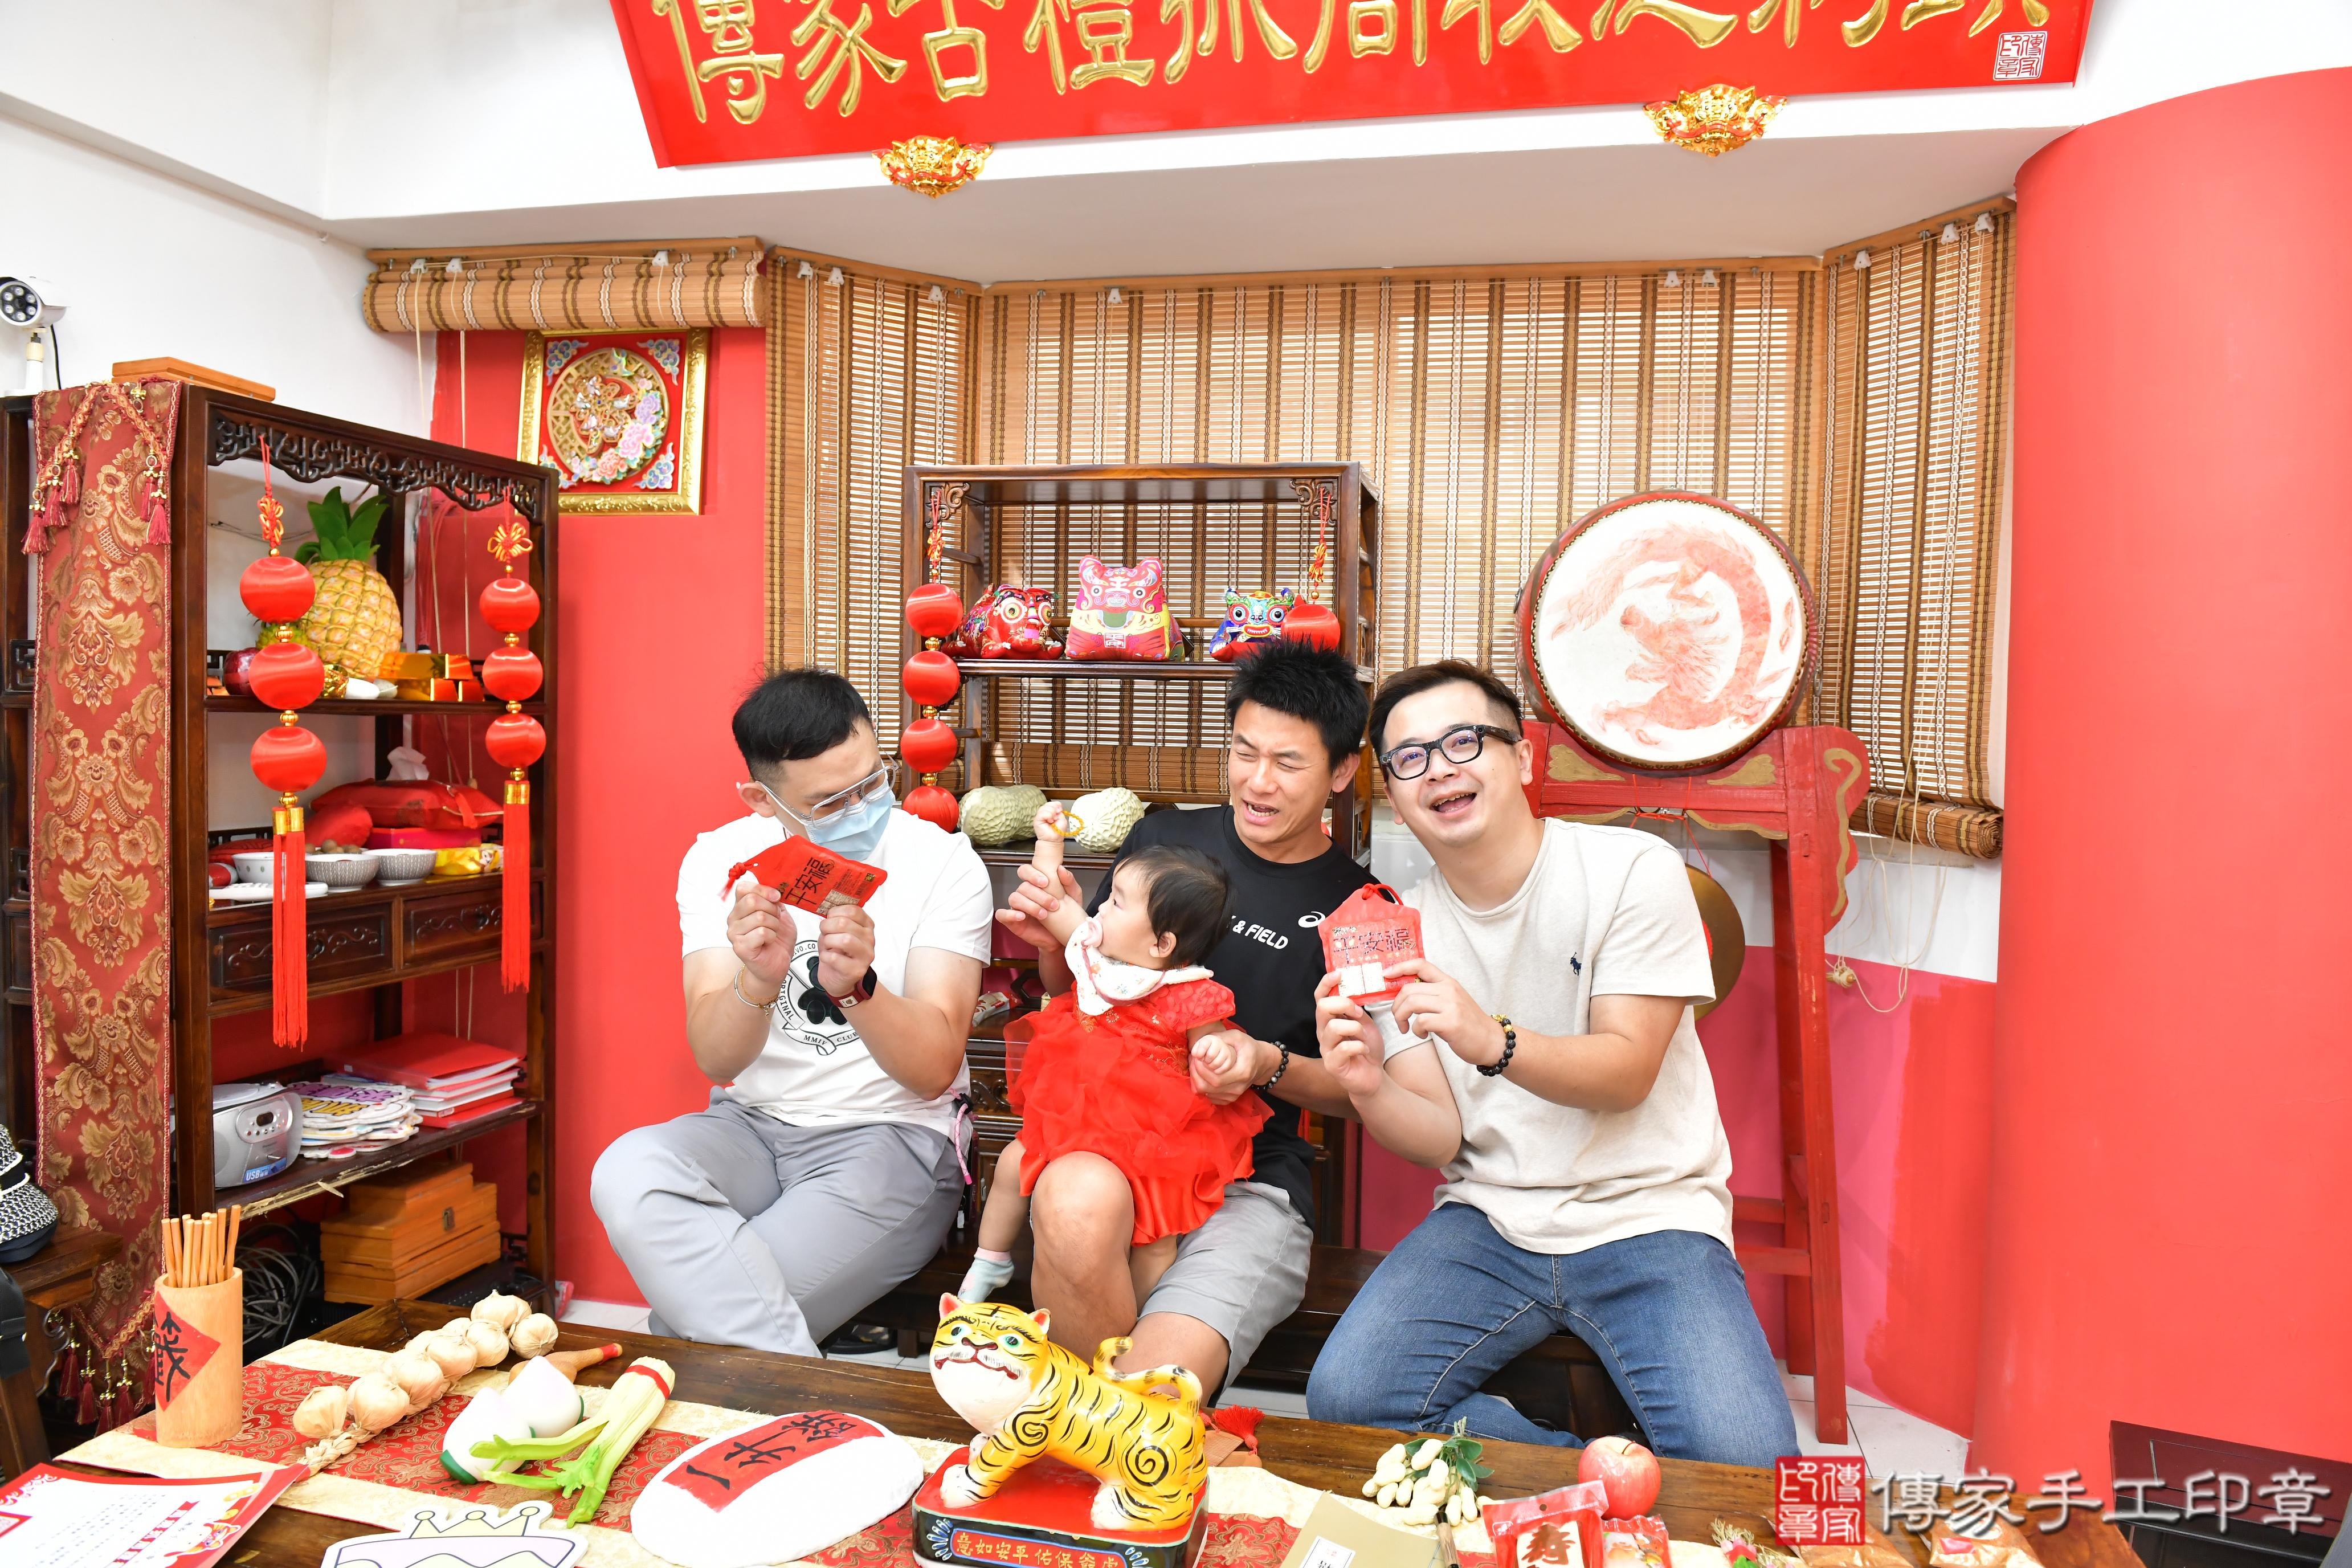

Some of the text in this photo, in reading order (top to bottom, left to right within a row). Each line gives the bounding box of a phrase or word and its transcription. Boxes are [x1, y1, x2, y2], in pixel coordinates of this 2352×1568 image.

[1232, 920, 1246, 934] &
[1244, 924, 1289, 949] FIELD
[803, 1035, 827, 1045] MMIV
[836, 1032, 858, 1042] CLUB
[246, 1170, 260, 1181] USB
